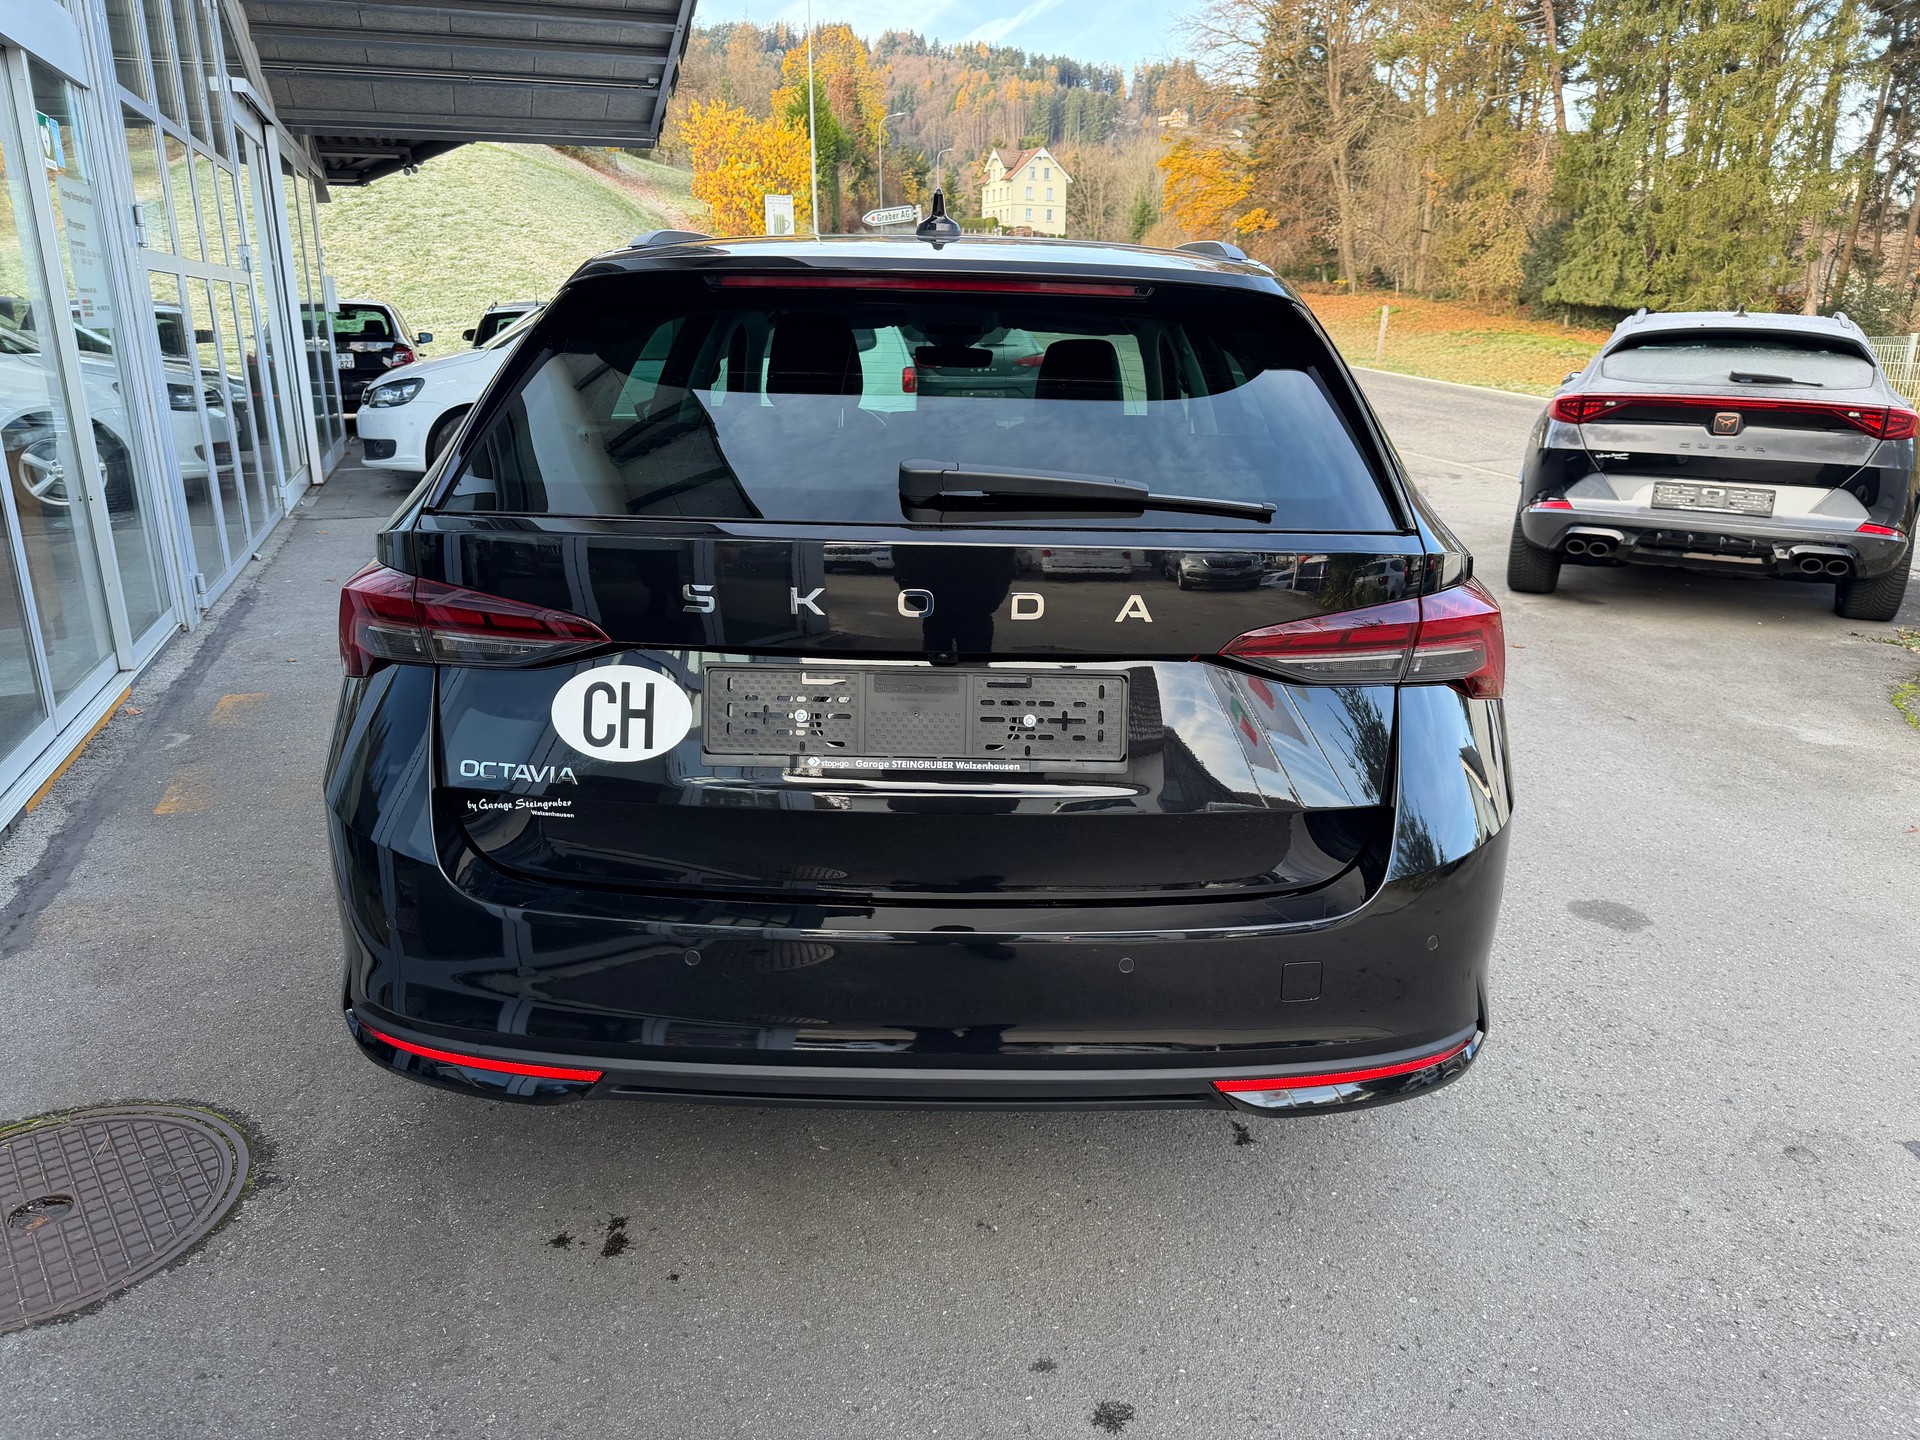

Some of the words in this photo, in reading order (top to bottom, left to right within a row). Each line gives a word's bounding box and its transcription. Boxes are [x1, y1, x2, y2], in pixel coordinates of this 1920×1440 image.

[876, 212, 899, 222] Graber
[900, 209, 911, 219] AG
[583, 681, 655, 749] CH
[459, 759, 578, 785] OCTAVIA
[855, 760, 890, 770] Garage
[891, 760, 954, 770] STEINGRUBER
[955, 761, 1021, 771] Walzenhausen
[467, 799, 477, 812] by
[478, 798, 513, 811] Garage
[514, 798, 572, 810] Steingruber
[530, 809, 575, 819] Walzenhausen
